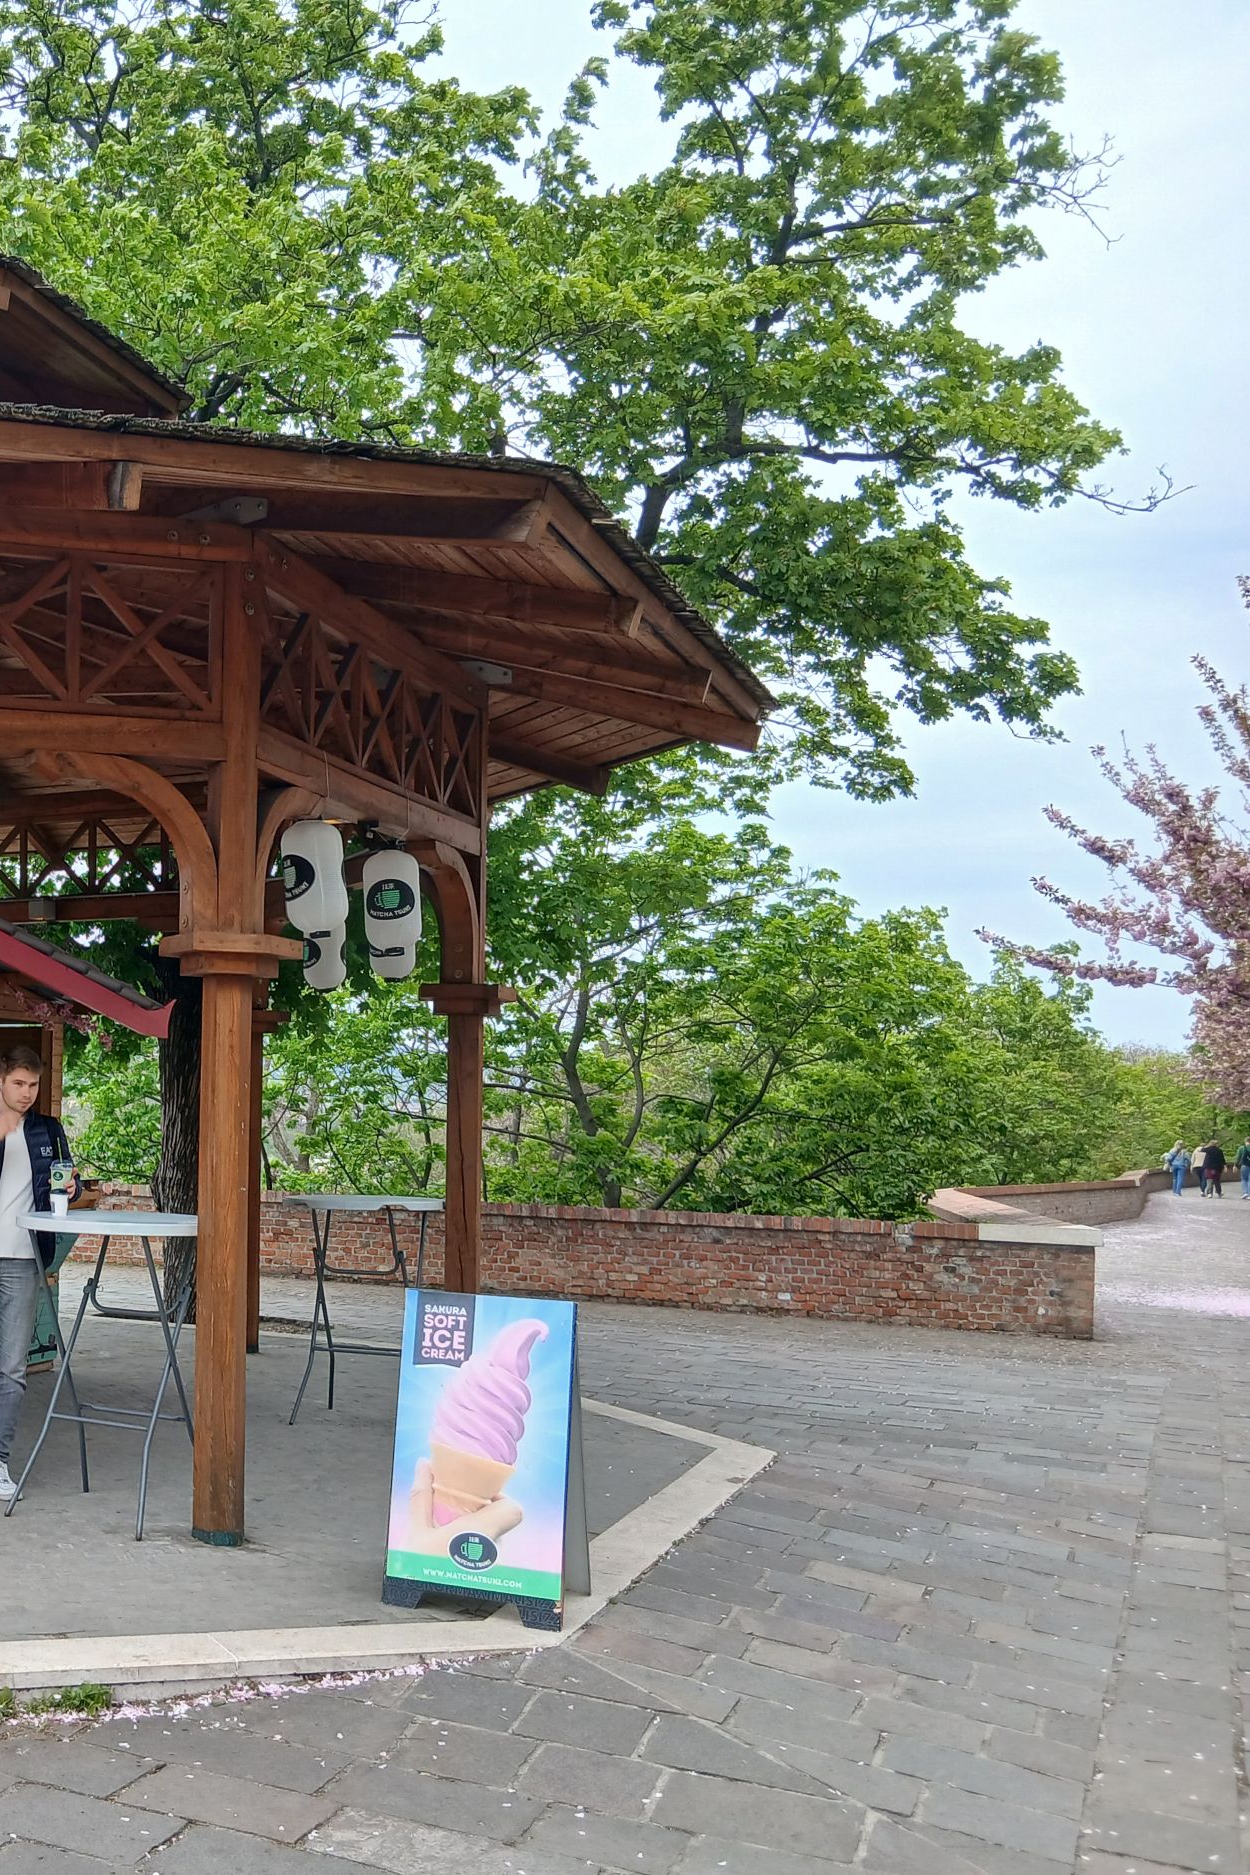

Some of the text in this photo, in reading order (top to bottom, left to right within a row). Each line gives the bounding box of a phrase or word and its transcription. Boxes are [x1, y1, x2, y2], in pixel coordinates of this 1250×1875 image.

[424, 1304, 468, 1315] SAKURA
[423, 1314, 467, 1330] SOFT
[422, 1328, 466, 1350] ICE
[421, 1347, 465, 1361] CREAM
[422, 1568, 523, 1588] WWW.MATCHATSUKI.COM
